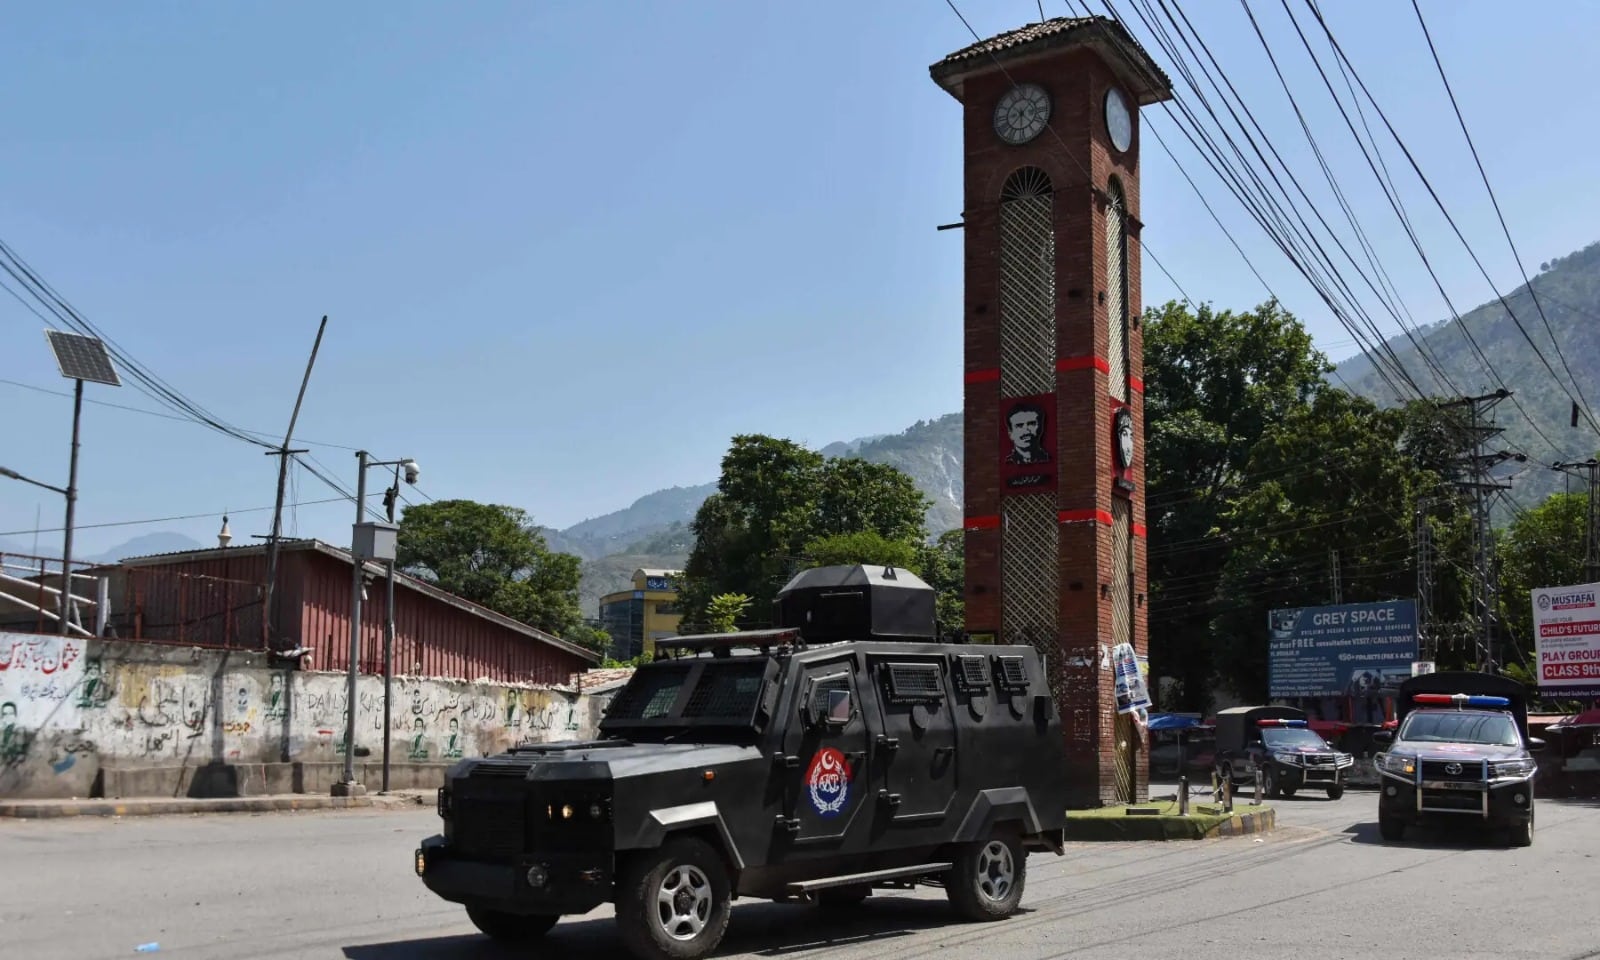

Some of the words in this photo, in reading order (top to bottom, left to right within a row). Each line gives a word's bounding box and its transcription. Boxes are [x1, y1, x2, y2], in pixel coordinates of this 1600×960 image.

[1551, 593, 1595, 605] MUSTAFAI
[1313, 611, 1348, 625] GREY
[1351, 609, 1395, 622] SPACE
[1541, 625, 1572, 636] CHILD'S
[1573, 623, 1600, 633] FUTUR
[1292, 638, 1314, 649] FREE
[1542, 651, 1566, 662] PLAY
[1544, 664, 1580, 677] CLASS
